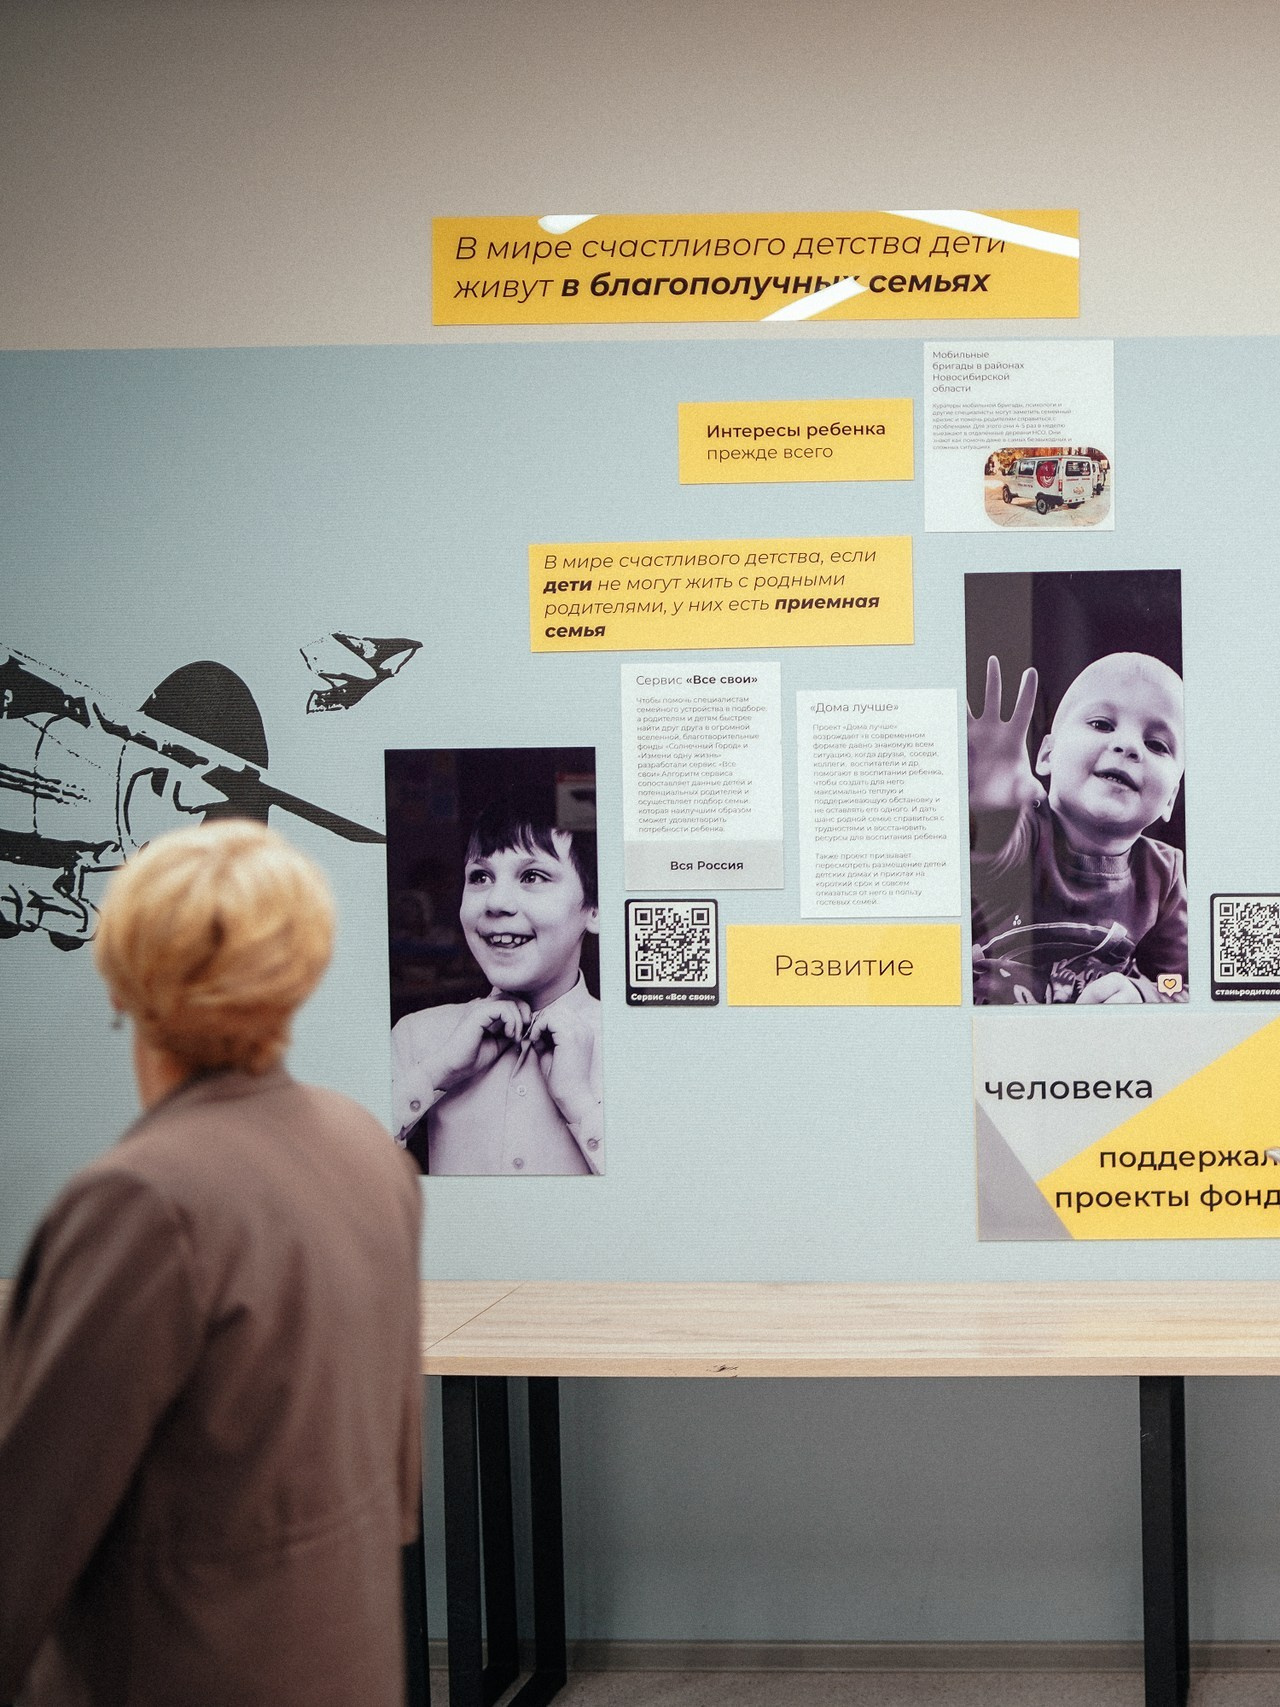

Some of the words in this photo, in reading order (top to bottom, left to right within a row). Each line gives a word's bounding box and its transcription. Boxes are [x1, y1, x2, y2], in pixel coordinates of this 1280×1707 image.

[455, 236, 477, 260] В
[486, 240, 572, 264] мире
[582, 237, 785, 258] счастливого
[792, 236, 921, 259] детства
[928, 235, 1005, 257] дети
[453, 279, 554, 304] живут
[560, 278, 579, 297] в
[590, 271, 860, 301] благополучны
[868, 274, 990, 293] семьях
[932, 350, 989, 358] Мобильные
[932, 361, 973, 371] бригады
[984, 361, 1024, 370] районах
[932, 372, 1009, 381] Новосибирской
[932, 384, 971, 392] области
[707, 424, 800, 440] Интересы
[806, 421, 885, 439] ребенка
[707, 448, 777, 463] прежде
[783, 447, 833, 458] всего
[544, 554, 557, 569] В
[562, 556, 613, 571] мире
[618, 553, 740, 567] счастливого
[743, 551, 824, 567] детства,
[830, 550, 876, 562] если
[542, 579, 592, 594] дети
[597, 579, 621, 590] не
[626, 578, 681, 593] могут
[685, 577, 733, 588] жить
[738, 576, 748, 588] с
[753, 574, 845, 591] родными
[544, 601, 666, 618] родителями,
[671, 601, 683, 616] у
[688, 600, 723, 611] них
[728, 599, 769, 611] есть
[774, 596, 880, 613] приемная
[544, 625, 605, 638] семья
[636, 675, 682, 686] Сервис
[686, 674, 716, 684] «Все
[719, 676, 757, 684] свои»
[810, 702, 849, 714] «Дома
[852, 703, 898, 714] лучше»
[670, 860, 693, 870] Вся
[697, 860, 743, 870] Россия
[776, 954, 913, 976] Развитие
[631, 993, 664, 1002] Сервис
[666, 993, 687, 1001] «Все
[984, 1079, 1152, 1100] человека
[1055, 1190, 1188, 1213] проекты
